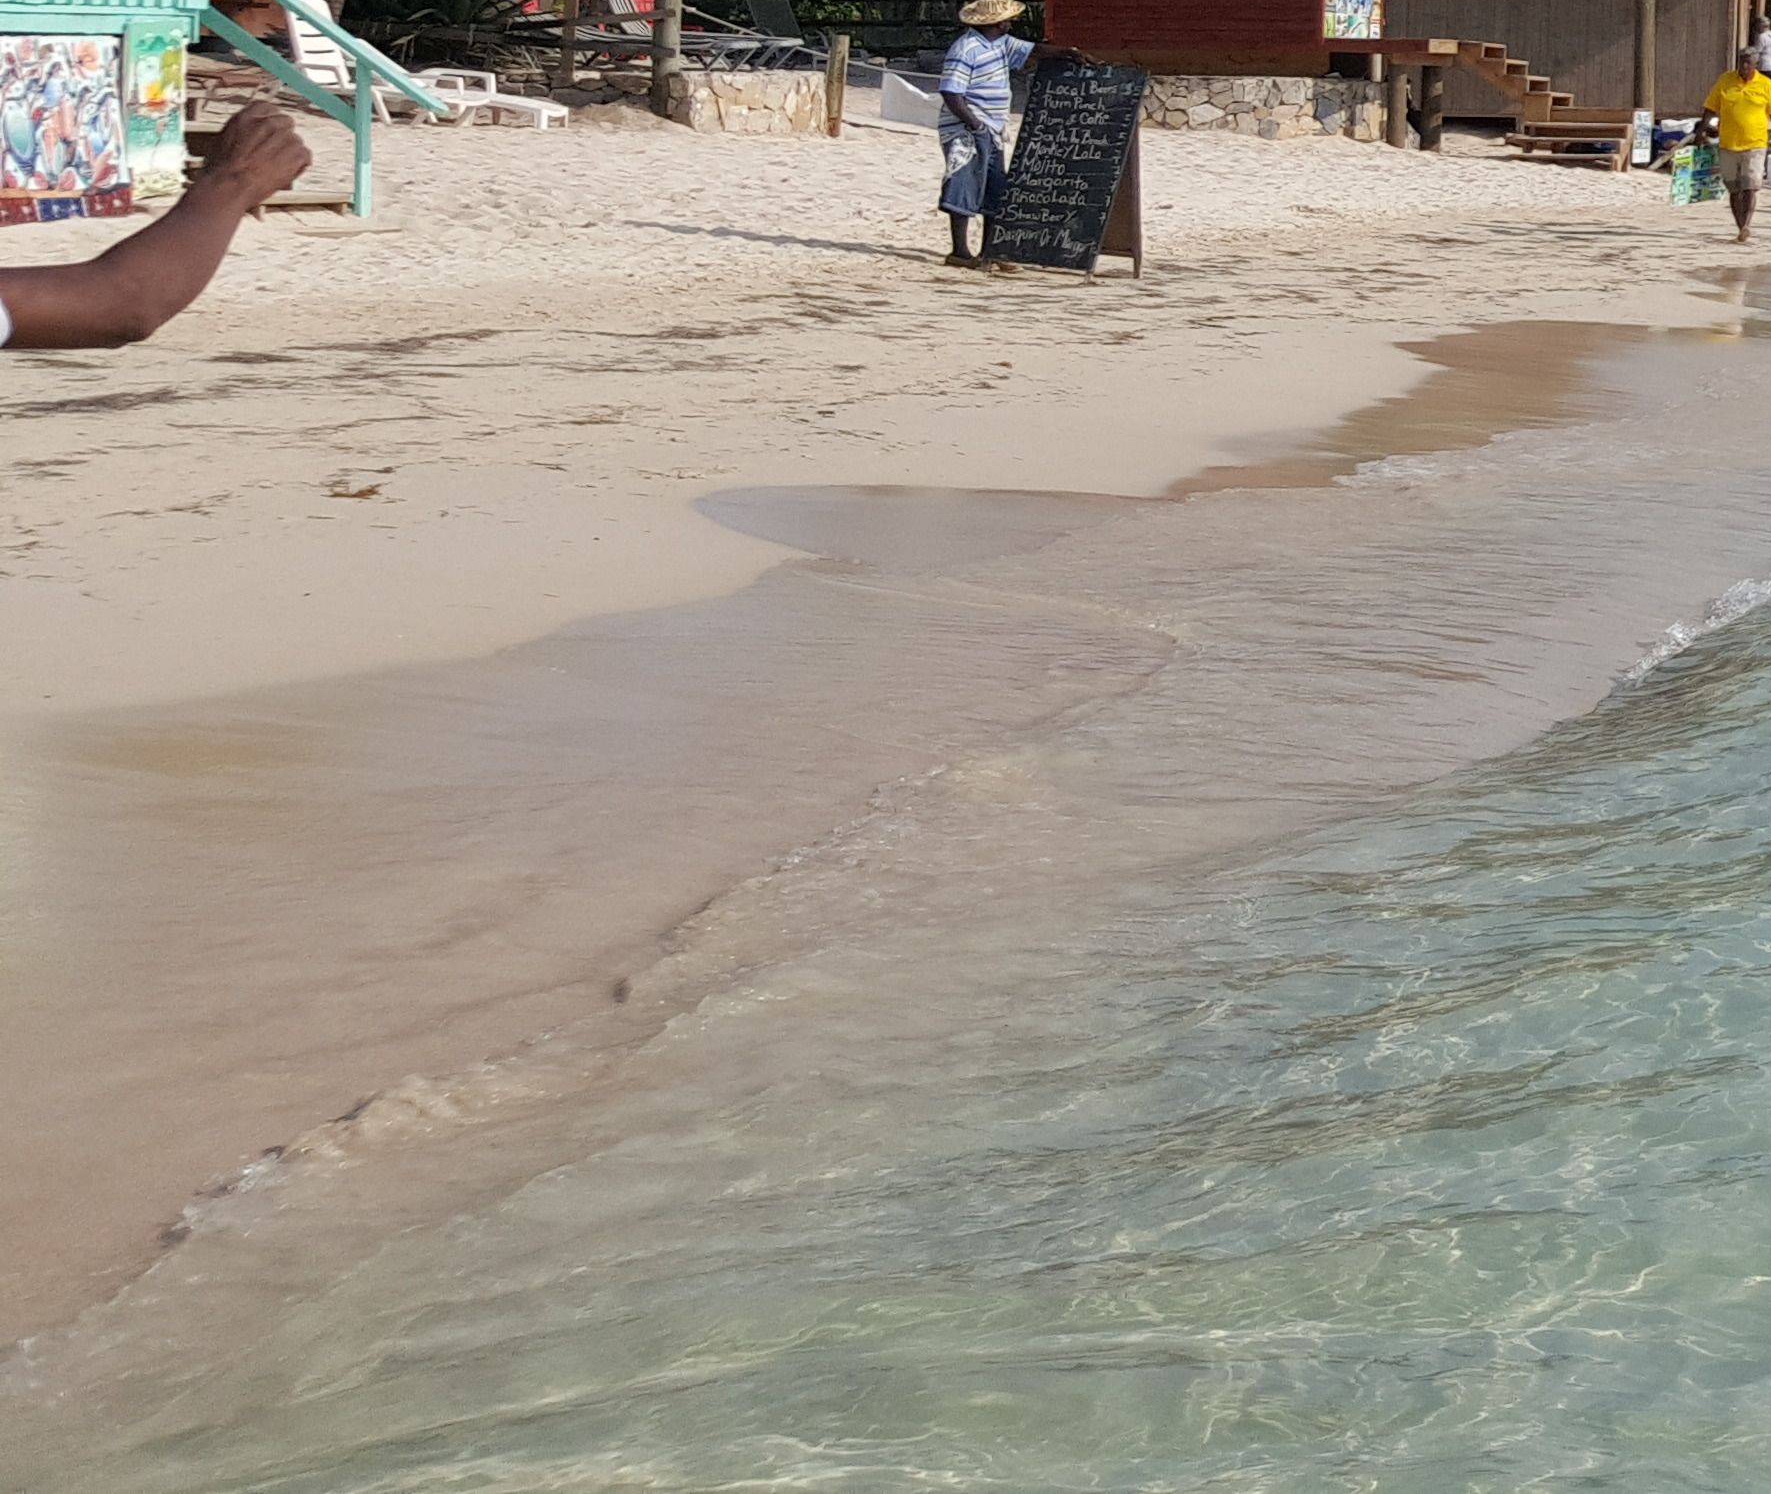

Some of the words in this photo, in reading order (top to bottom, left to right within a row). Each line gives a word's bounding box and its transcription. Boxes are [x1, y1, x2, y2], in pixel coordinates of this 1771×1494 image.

[1046, 80, 1086, 96] Local
[1042, 94, 1071, 109] Rum
[1074, 96, 1106, 111] Punch
[1037, 110, 1064, 125] Rum
[1020, 156, 1066, 175] Mojito
[1015, 173, 1089, 192] Margarita
